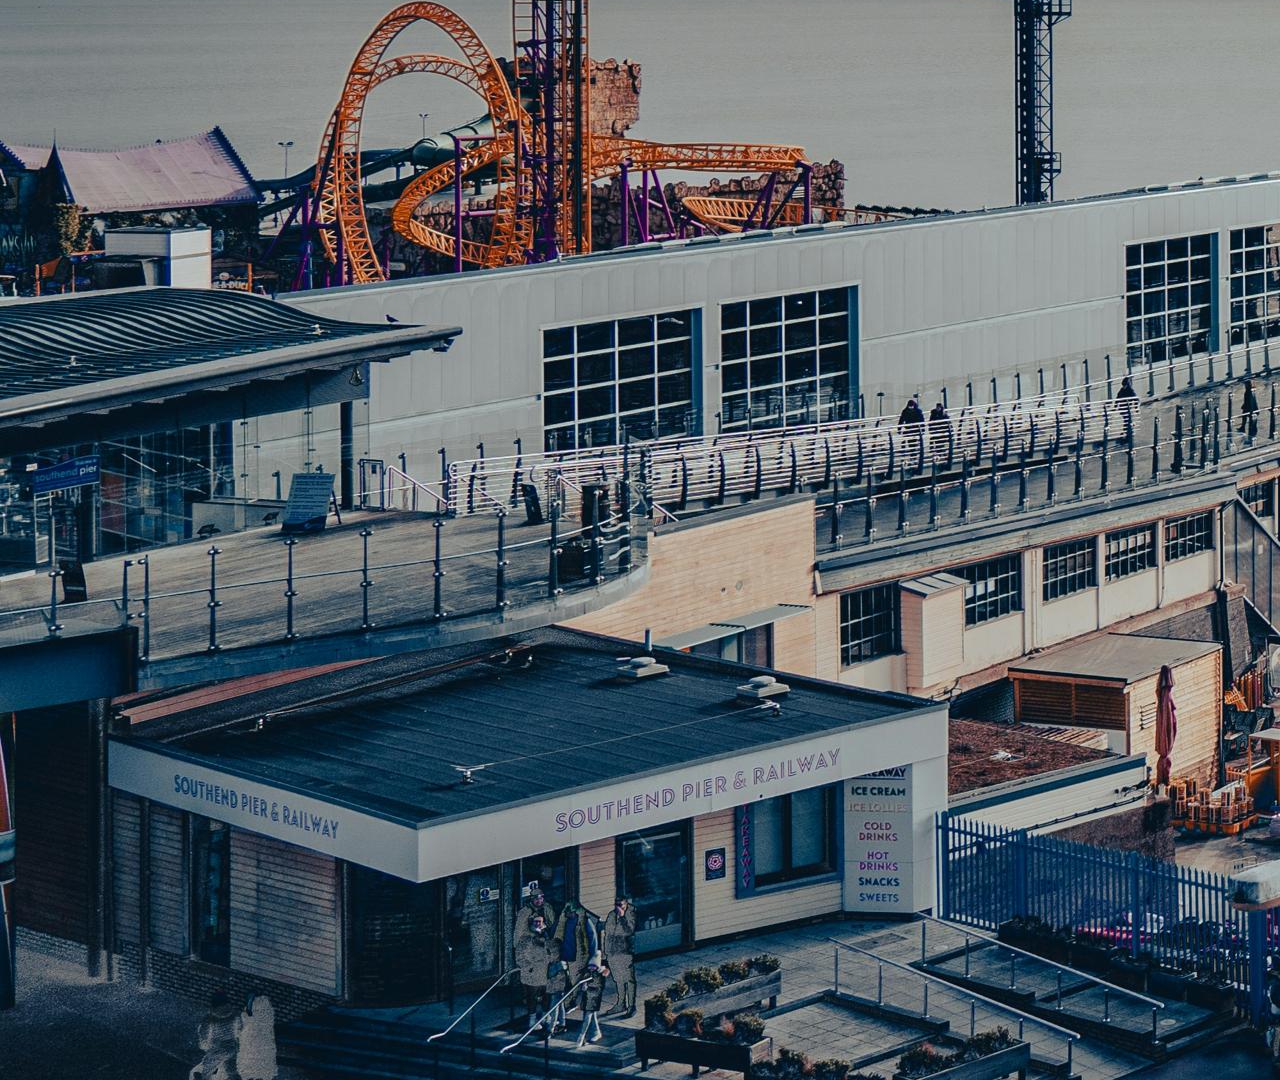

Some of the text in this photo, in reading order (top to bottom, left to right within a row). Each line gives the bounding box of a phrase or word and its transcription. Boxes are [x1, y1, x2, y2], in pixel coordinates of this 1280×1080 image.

[35, 465, 97, 483] southend pier
[555, 748, 840, 833] SOUTHEND PIER & RAILWAY
[851, 786, 906, 797] ICE CREAM
[173, 774, 339, 839] SOUTHEND PIER & RAILWAY
[849, 803, 907, 813] ICE LOLLIES
[864, 822, 892, 831] COLD
[859, 832, 898, 841] DRINKS
[867, 851, 889, 860] HOT
[859, 862, 898, 871] DRINKS
[858, 877, 900, 887] SNACKS
[859, 892, 900, 903] SWEETS
